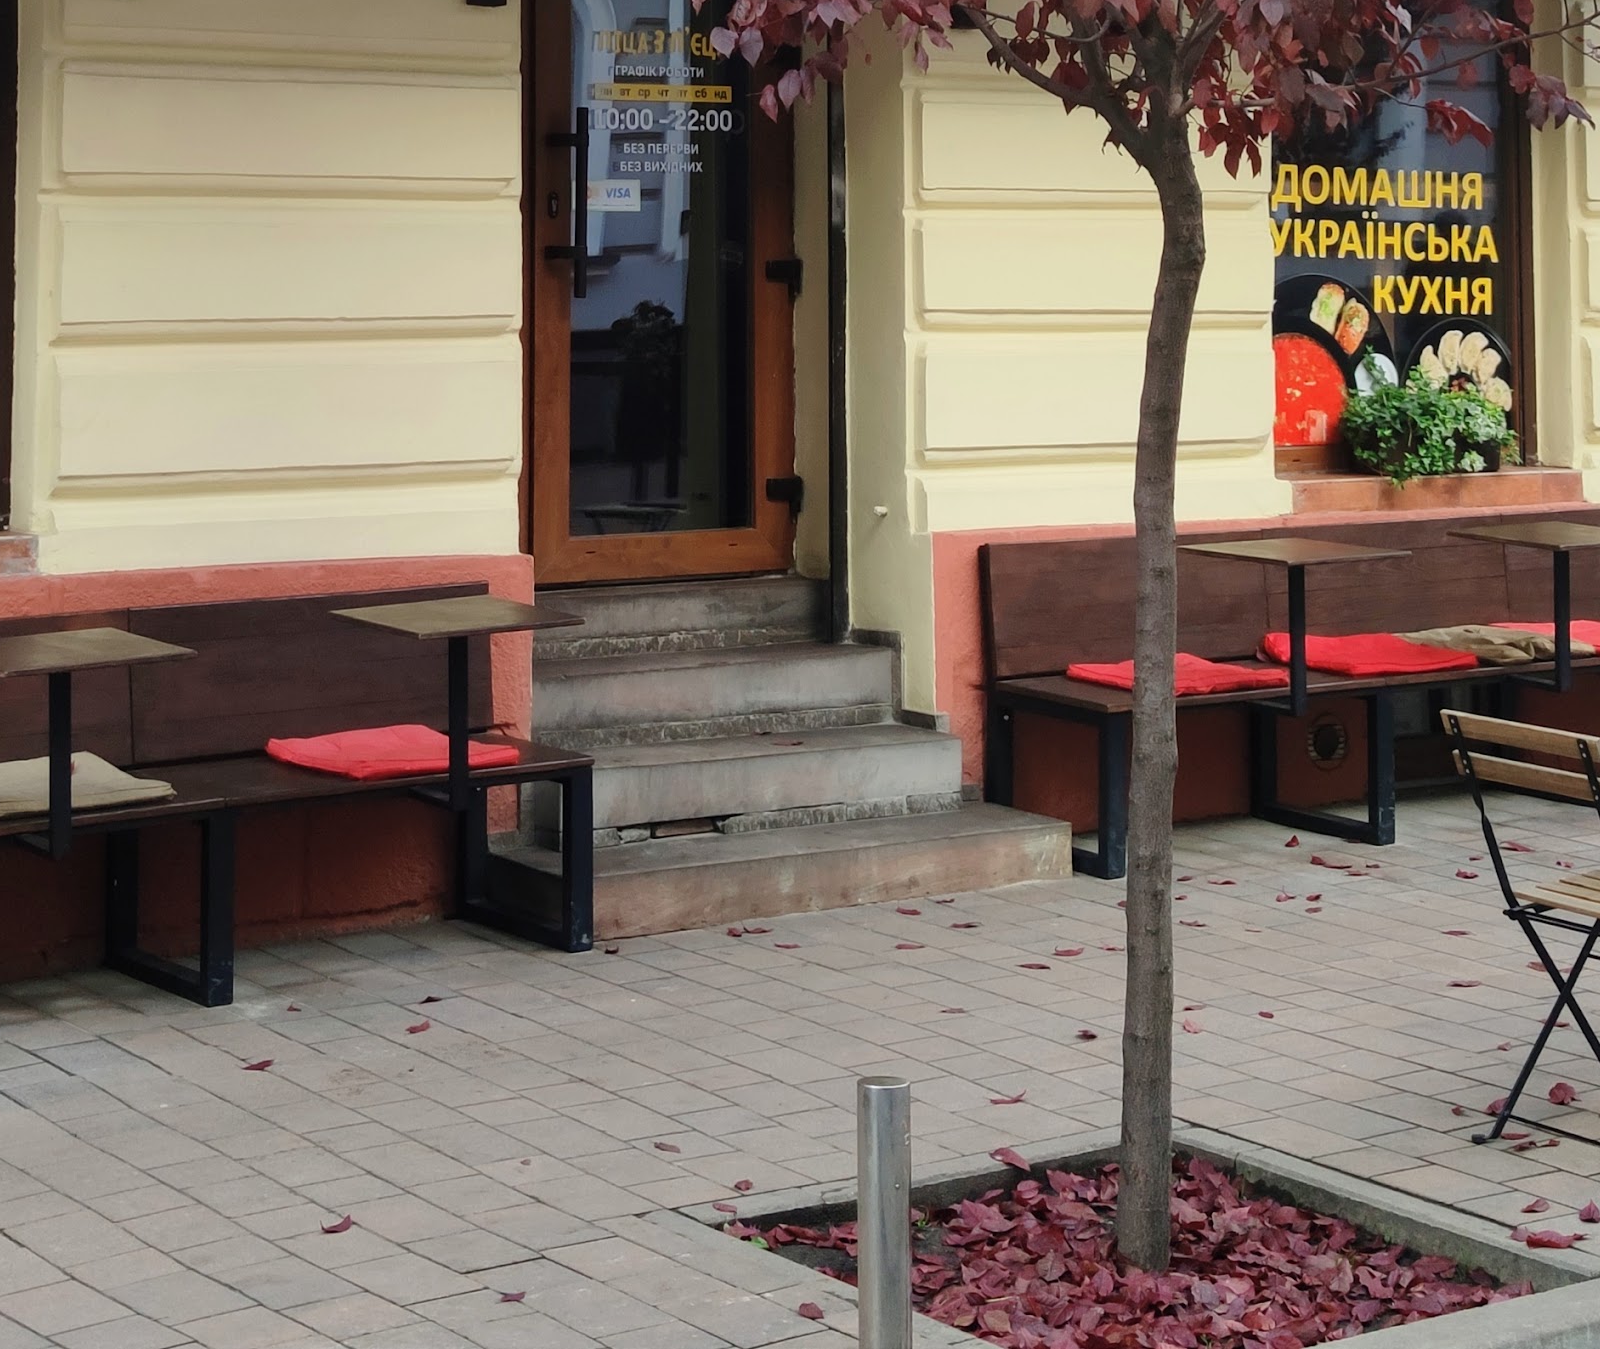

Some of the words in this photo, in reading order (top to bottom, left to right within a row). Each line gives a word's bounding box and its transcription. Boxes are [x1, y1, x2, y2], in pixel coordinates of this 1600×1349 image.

[615, 64, 656, 77] ГРАФІК
[659, 66, 704, 78] РОБОТИ
[620, 87, 631, 97] вт
[638, 89, 650, 99] ср
[658, 89, 669, 98] чт
[695, 87, 707, 99] сб
[714, 90, 727, 100] нд
[594, 108, 653, 130] 10:00
[674, 109, 733, 132] 22:00
[623, 143, 644, 154] БЕЗ
[648, 143, 699, 155] ПЕРЕРВИ
[619, 161, 642, 172] БЕЗ
[644, 161, 703, 173] ВИХІДНИХ
[606, 187, 631, 198] VISA
[1271, 164, 1483, 212] ДОМАШНЯ
[1269, 211, 1499, 263] УКРАЇНСЬКА
[1373, 276, 1494, 315] КУХНЯ
